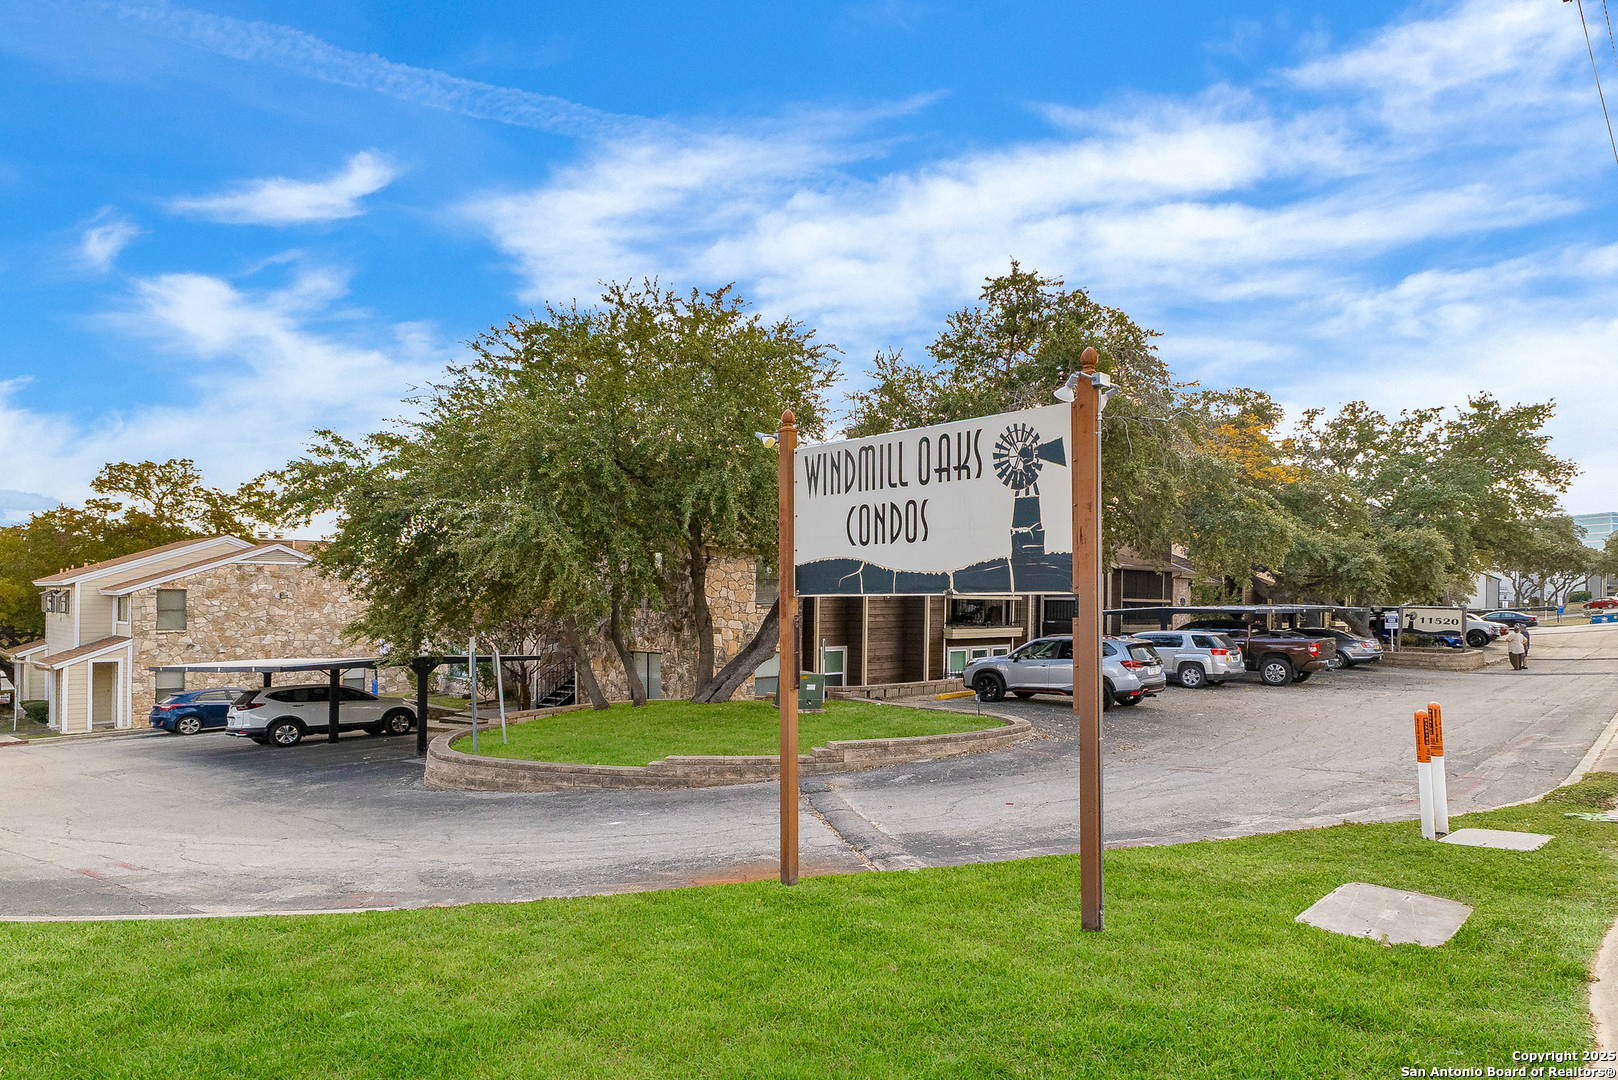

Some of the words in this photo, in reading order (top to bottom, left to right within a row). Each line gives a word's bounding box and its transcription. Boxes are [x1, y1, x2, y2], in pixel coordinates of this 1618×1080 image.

[804, 440, 909, 499] WINDMILL
[918, 428, 984, 486] OAKS
[846, 498, 930, 547] CONDOS
[1420, 617, 1459, 625] 11520
